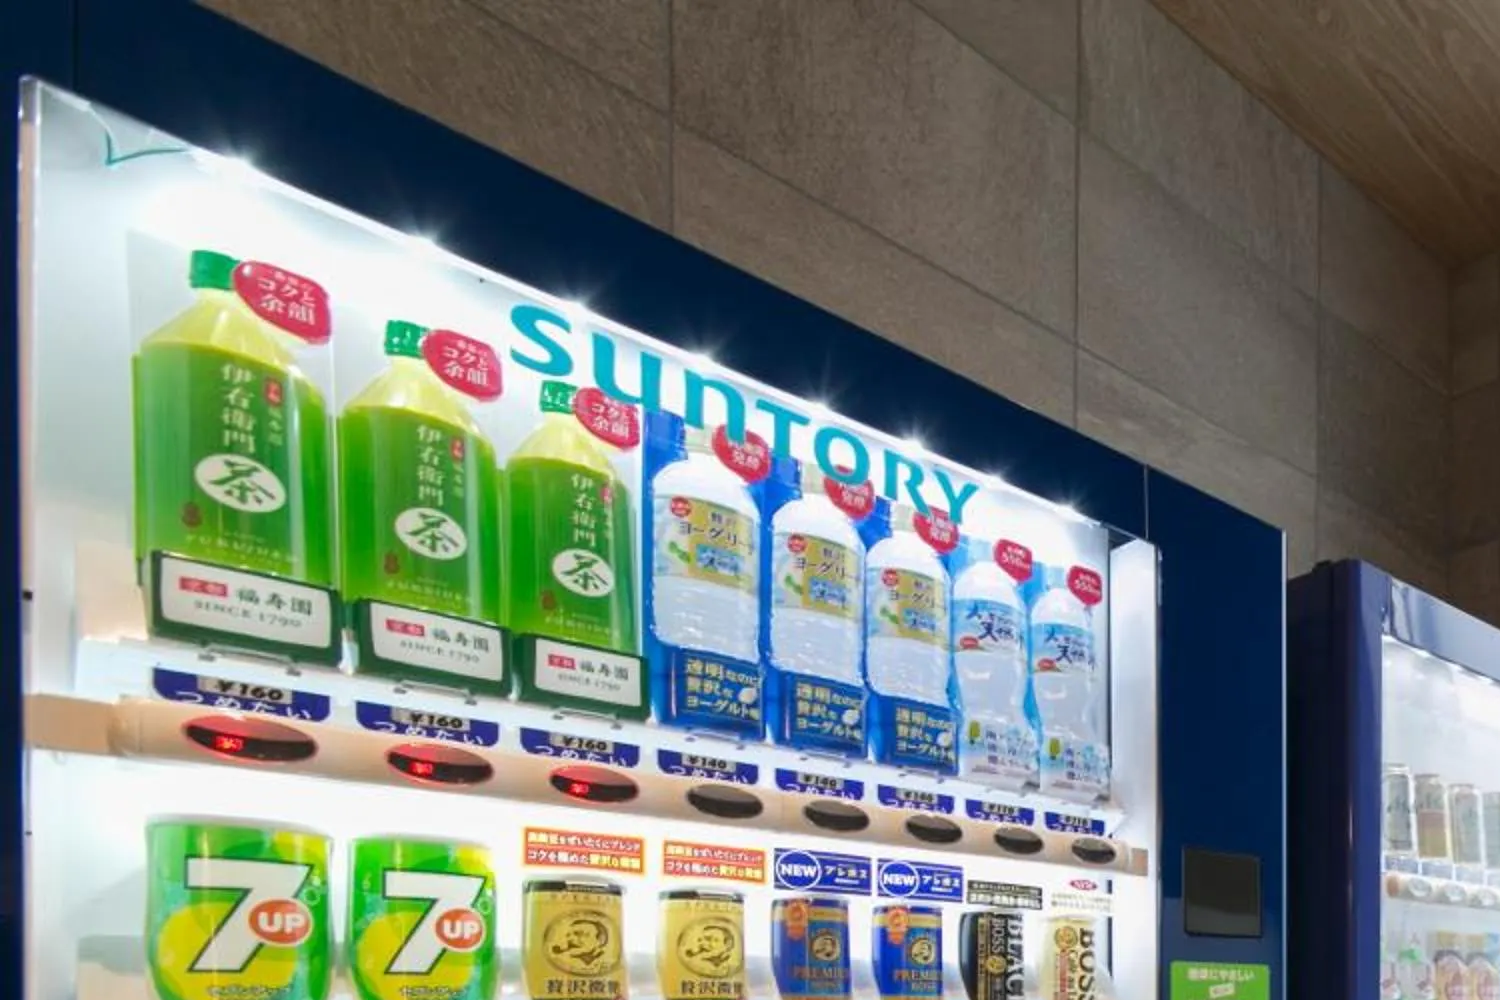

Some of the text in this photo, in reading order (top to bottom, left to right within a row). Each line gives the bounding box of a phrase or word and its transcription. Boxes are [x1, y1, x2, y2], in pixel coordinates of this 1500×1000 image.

[510, 304, 979, 524] SUNTORY
[209, 459, 277, 505] 茶
[406, 512, 460, 553] 茶
[561, 553, 609, 591] 茶
[217, 680, 285, 701] ¥160
[410, 712, 463, 730] ¥160
[563, 734, 608, 751] ¥160
[780, 863, 817, 878] NEW
[883, 873, 916, 886] NEW
[184, 855, 314, 973] 7 UP
[382, 869, 487, 974] 7 UP
